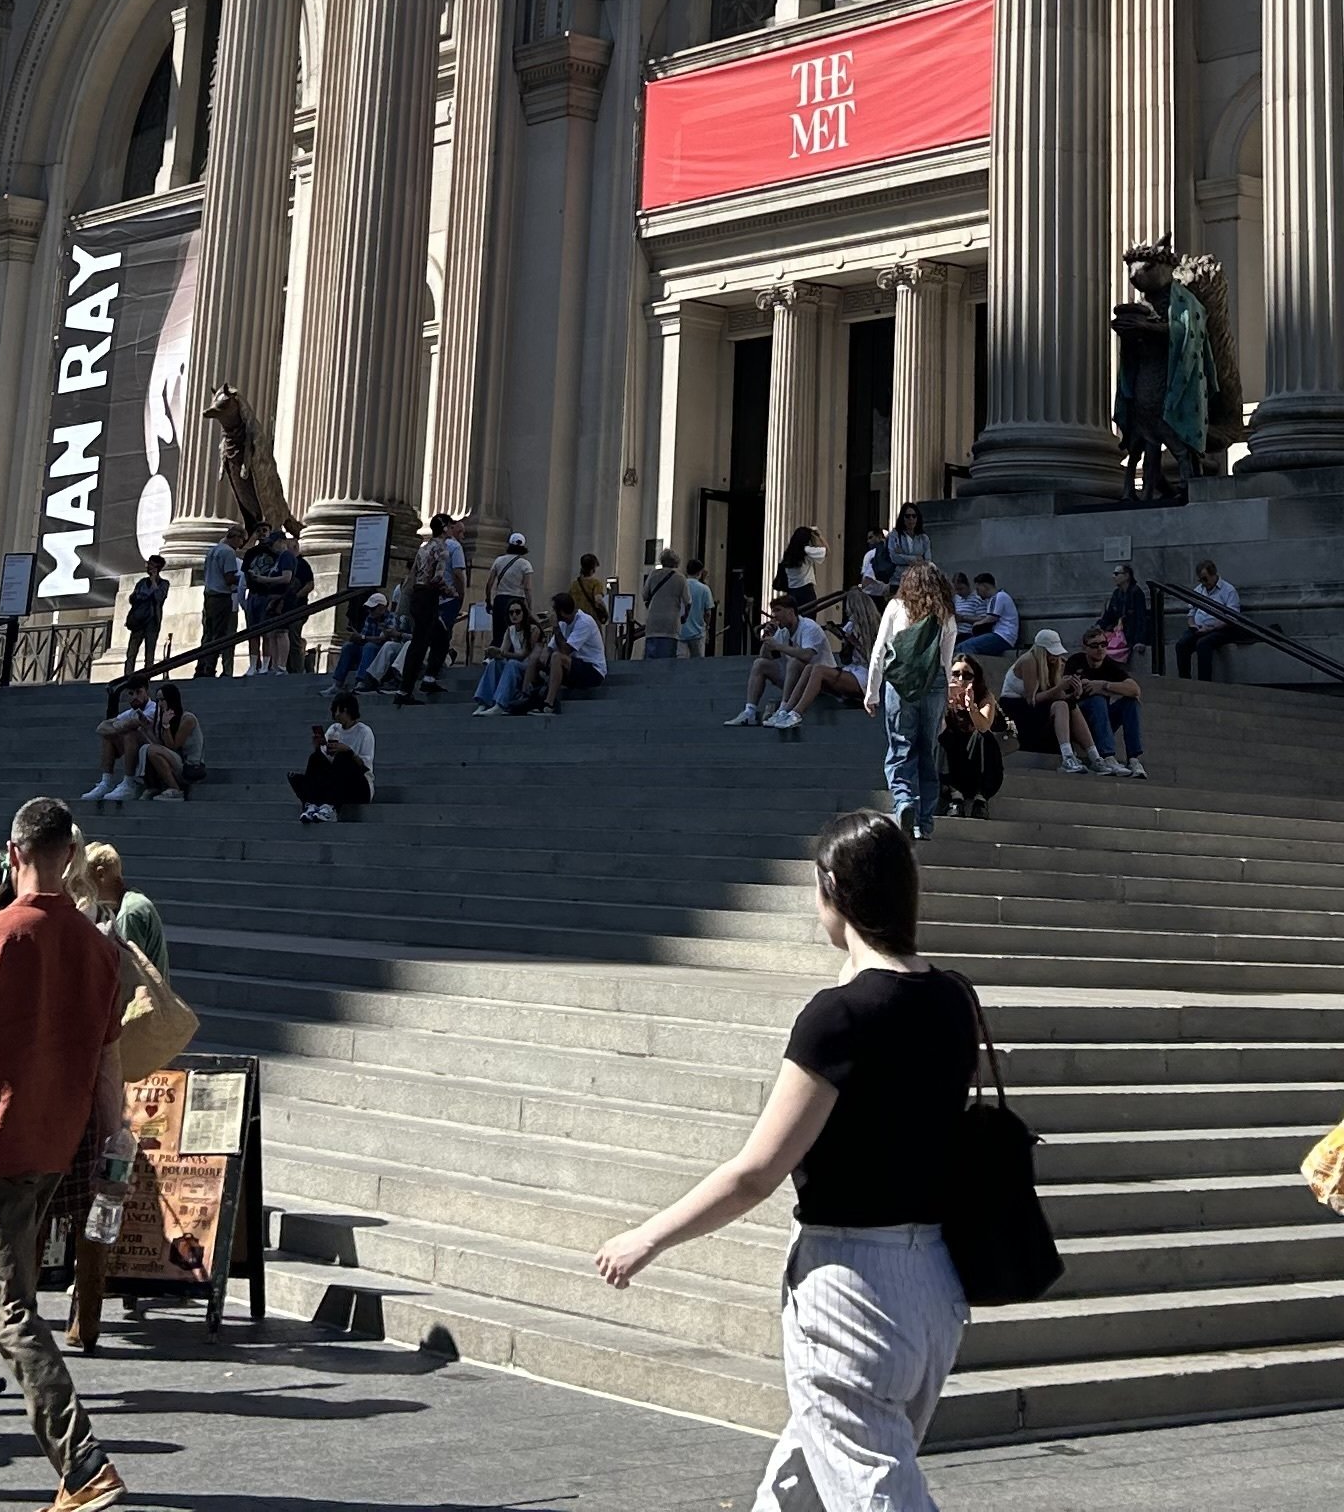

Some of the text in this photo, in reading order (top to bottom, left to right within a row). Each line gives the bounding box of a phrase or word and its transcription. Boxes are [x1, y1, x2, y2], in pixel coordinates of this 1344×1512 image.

[791, 49, 854, 108] THE
[788, 100, 856, 159] MET
[37, 244, 122, 598] MAN RAY
[132, 1087, 176, 1104] TIPS
[144, 1076, 169, 1087] FOR
